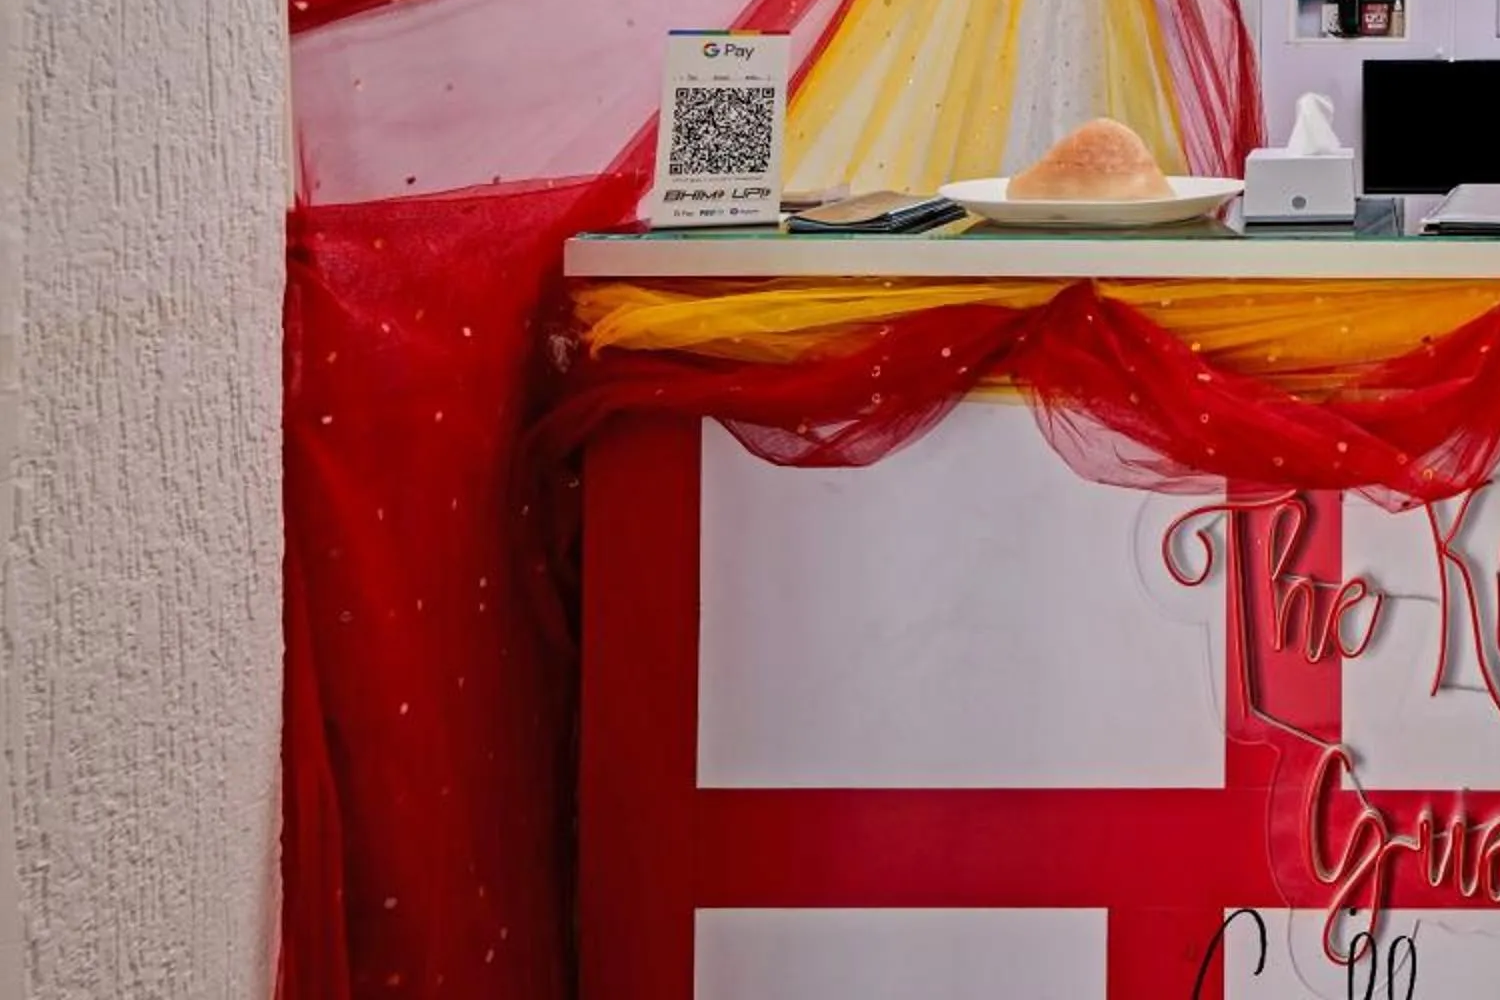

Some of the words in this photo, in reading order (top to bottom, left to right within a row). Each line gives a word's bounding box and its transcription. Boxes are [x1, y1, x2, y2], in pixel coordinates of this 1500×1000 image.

[703, 43, 720, 58] G
[724, 43, 755, 61] Pay
[1161, 488, 1384, 720] The
